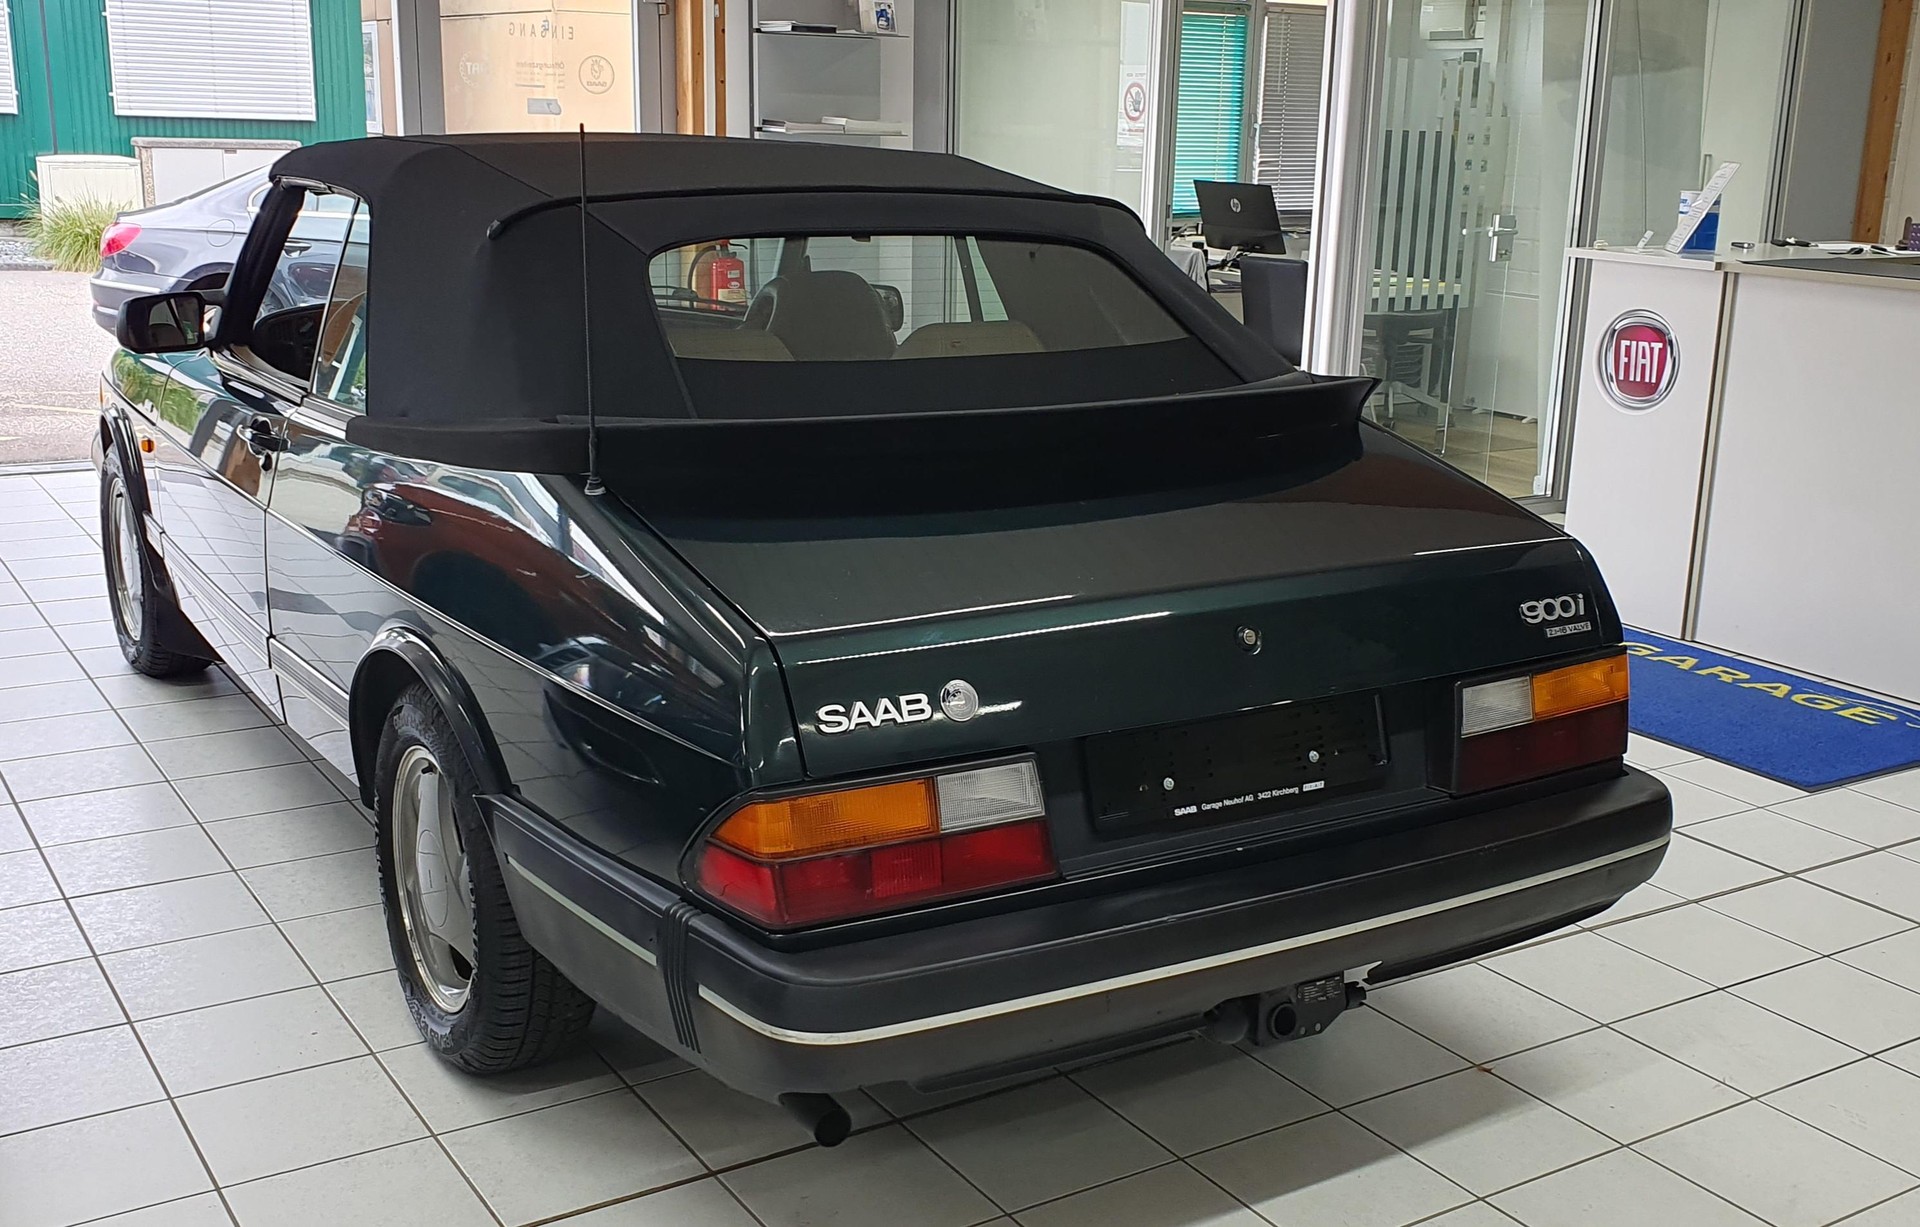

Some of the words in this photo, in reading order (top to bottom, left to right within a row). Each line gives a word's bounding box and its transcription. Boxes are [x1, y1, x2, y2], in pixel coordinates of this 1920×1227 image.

[1619, 340, 1664, 383] FIAT
[1519, 593, 1585, 624] 900i
[1568, 623, 1590, 632] VALVE
[1620, 641, 1898, 725] GARAGE
[817, 692, 933, 734] SAAB
[1174, 805, 1198, 816] SAAB
[1201, 802, 1223, 811] Garage
[1223, 796, 1244, 806] Neuhof
[1244, 794, 1254, 802] AG
[1257, 791, 1272, 800] 3422
[1272, 786, 1299, 797] Kirchberg
